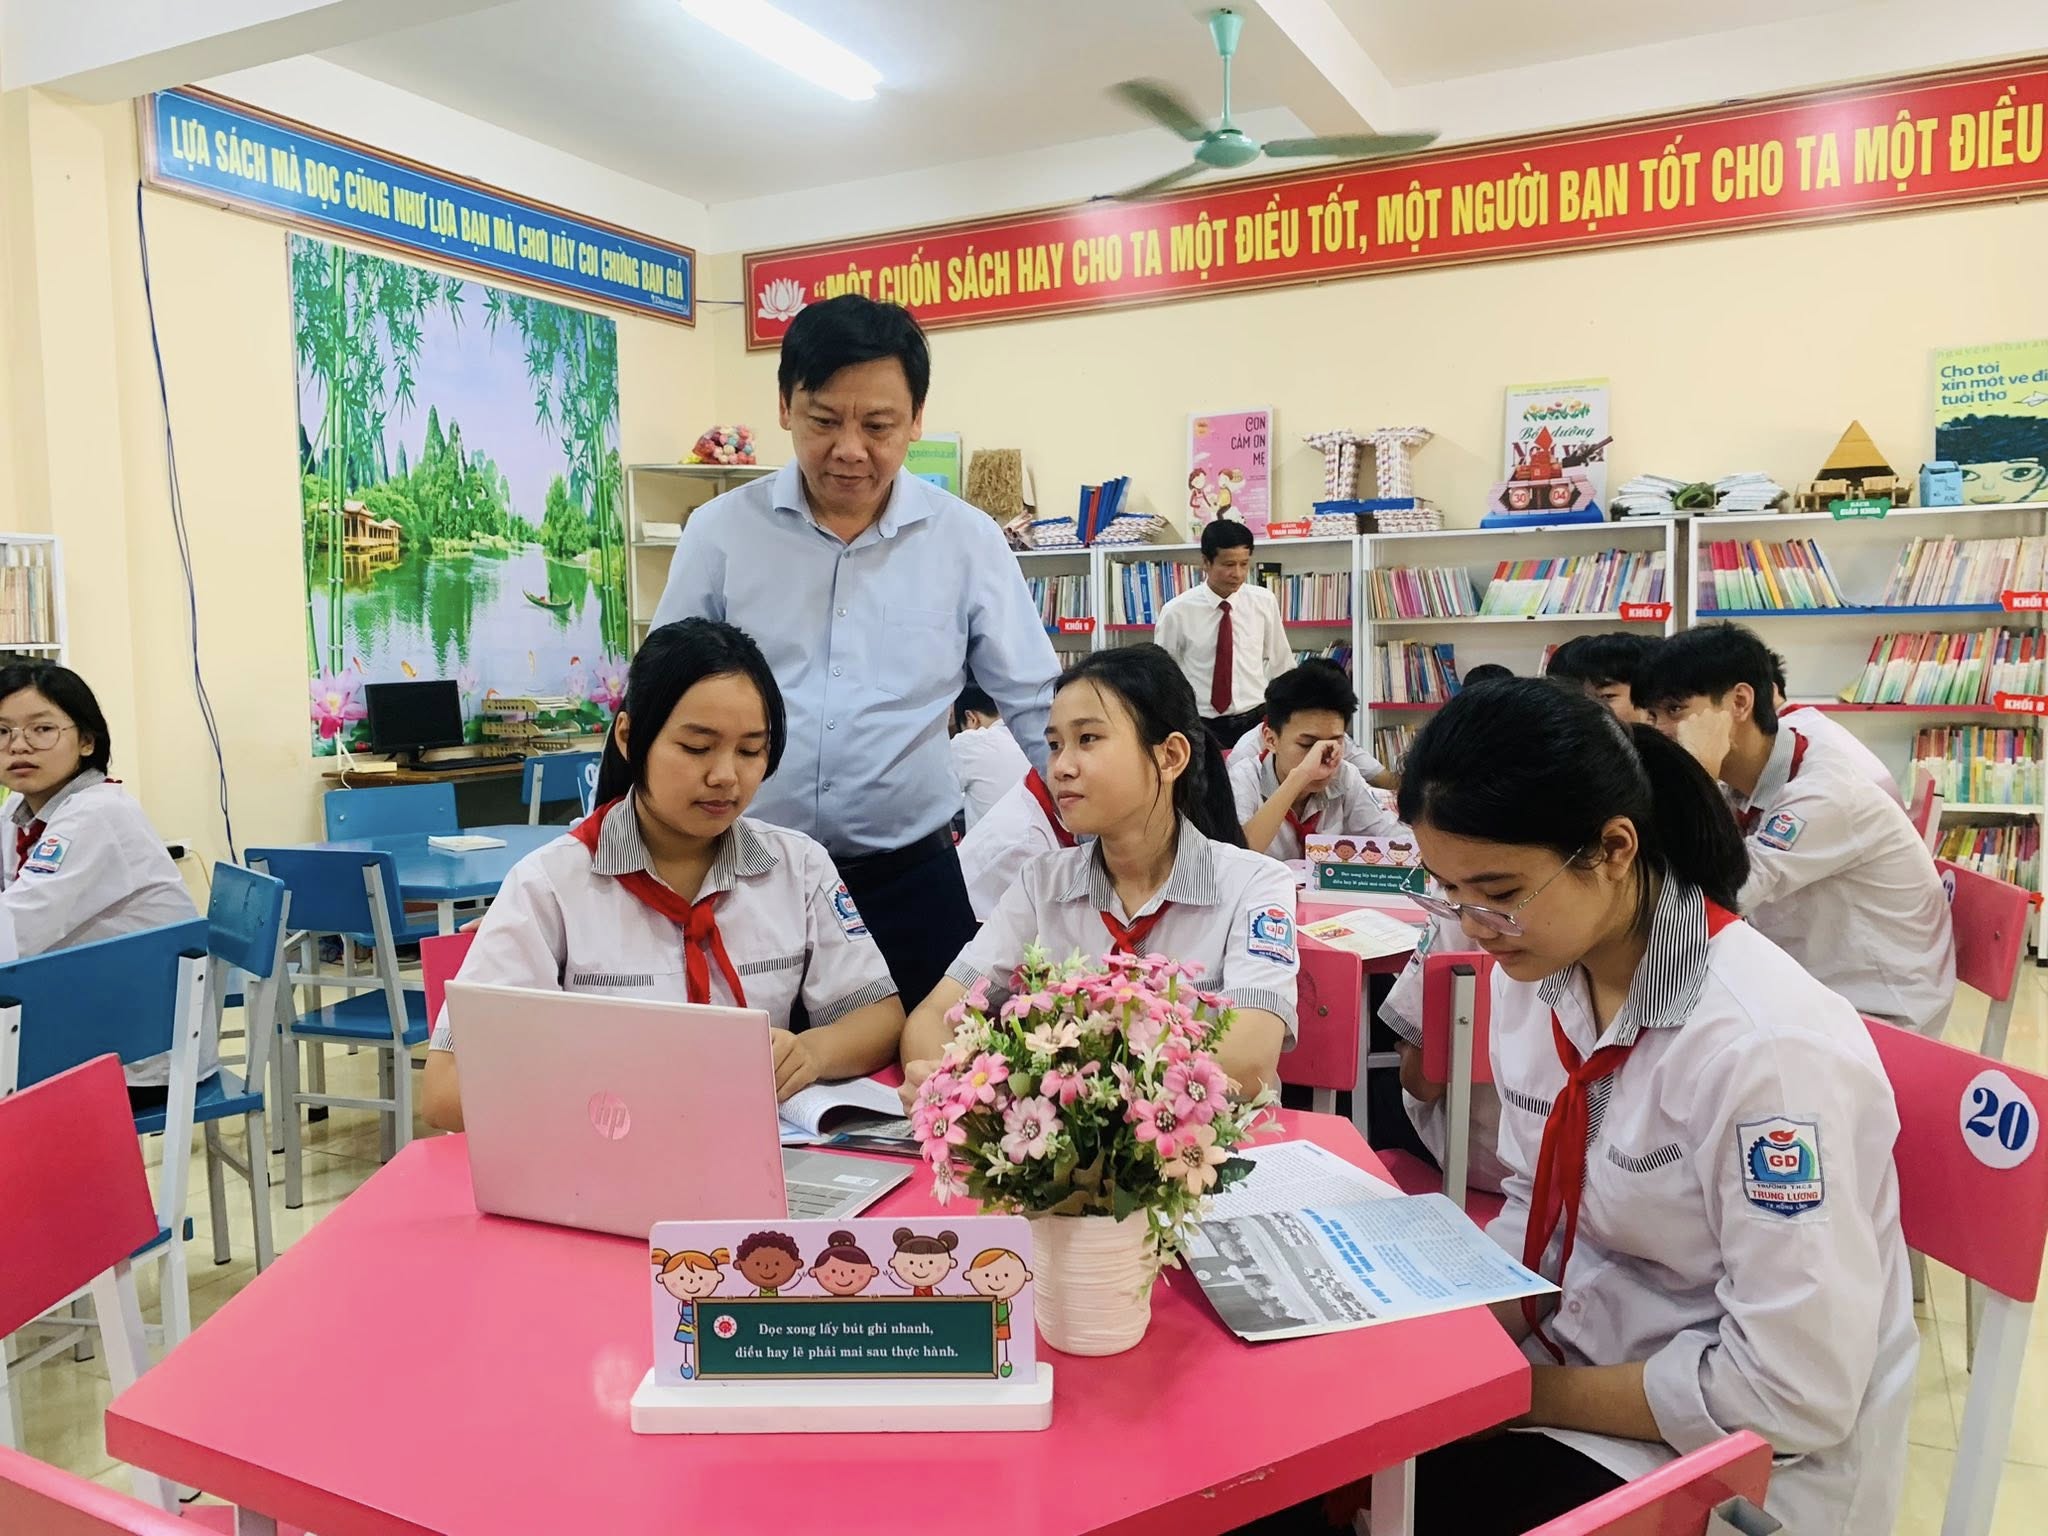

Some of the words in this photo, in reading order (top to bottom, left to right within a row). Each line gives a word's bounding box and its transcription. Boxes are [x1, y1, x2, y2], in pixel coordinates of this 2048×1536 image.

[170, 116, 211, 171] LỰA
[215, 126, 267, 183] SÁCH
[271, 145, 302, 193] MÀ
[305, 158, 340, 209] ĐỌC
[345, 167, 390, 219] CŨNG
[393, 186, 427, 229] NHƯ
[429, 197, 458, 243] LỰA
[460, 207, 490, 252] BẠN
[493, 213, 516, 255] MÀ
[551, 230, 575, 271] HÃY
[578, 242, 598, 277] COI
[879, 246, 940, 307] CUỐN
[948, 245, 1010, 302] SÁCH
[1018, 242, 1065, 293] HAY
[1072, 234, 1122, 286] CHO
[1130, 229, 1162, 277] TA
[1170, 211, 1226, 280] MỘT
[1235, 194, 1299, 264] ĐIỀU
[1307, 183, 1367, 255] TỐT,
[1377, 180, 1442, 253] MỘT
[1451, 162, 1549, 237] NGƯỜI
[1560, 162, 1628, 231] BẠN
[1639, 134, 1701, 212] TỐT
[1712, 140, 1783, 203] CHO
[1796, 132, 1841, 192] TA
[1854, 109, 1938, 192] MỘT
[1949, 86, 2043, 172] ĐIỀU
[1941, 365, 1974, 378] Cho
[1942, 378, 1966, 391] xin
[1245, 416, 1266, 432] CON
[1253, 451, 1266, 467] MẸ
[1513, 492, 1526, 503] 30
[1553, 490, 1569, 501] 04
[1965, 1087, 2029, 1150] 20
[1769, 1155, 1797, 1167] GD
[1752, 1190, 1784, 1200] TRUNG
[786, 1326, 816, 1337] xong
[820, 1322, 839, 1337] lấy
[843, 1322, 864, 1334] bút
[868, 1322, 887, 1337] ghi
[891, 1322, 934, 1335] nhanh,
[767, 1346, 789, 1360] hay
[808, 1346, 836, 1360] phải
[840, 1346, 863, 1357] mai
[866, 1349, 888, 1357] sau
[891, 1346, 919, 1359] thực
[923, 1345, 959, 1358] hành.
